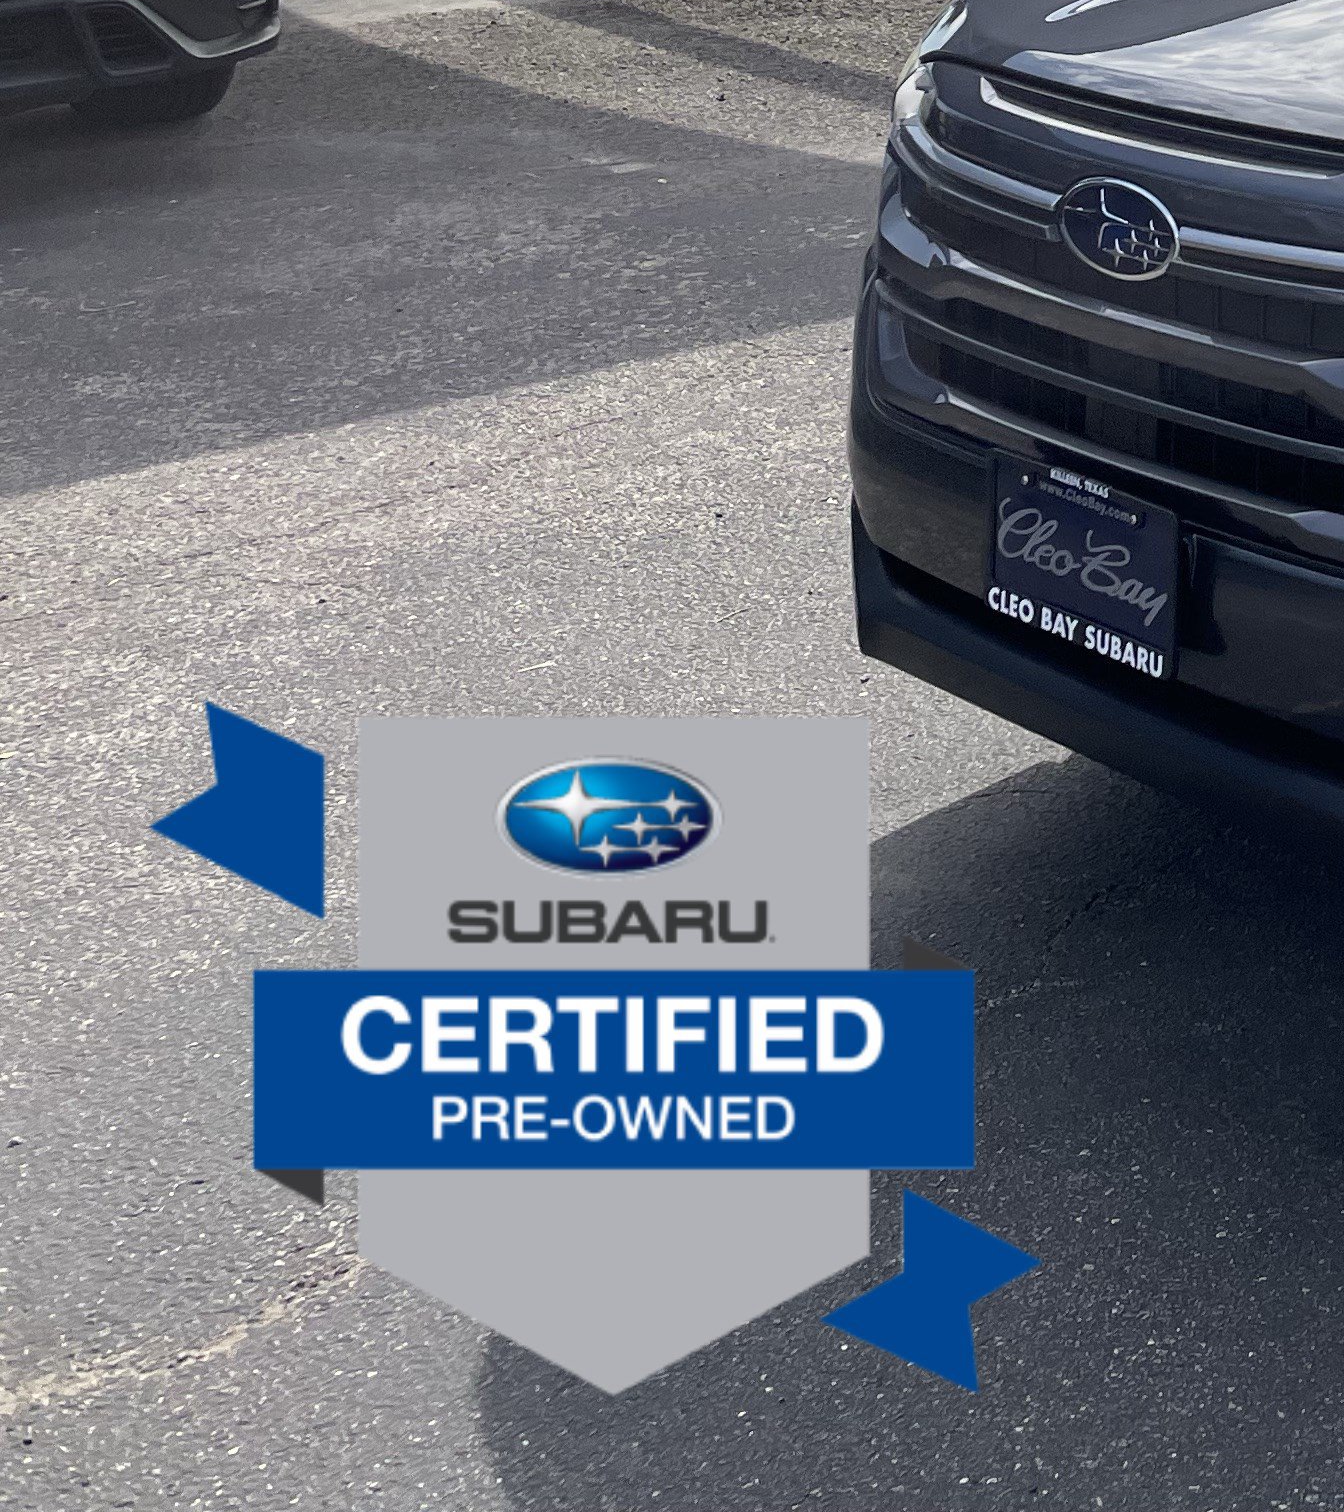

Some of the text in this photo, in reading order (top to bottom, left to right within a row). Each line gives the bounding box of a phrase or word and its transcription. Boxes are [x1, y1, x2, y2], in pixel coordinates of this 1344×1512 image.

[1083, 478, 1109, 499] TEXAS
[997, 497, 1168, 627] Cleo Bay
[987, 586, 1164, 679] CLEO BAY SUBARU
